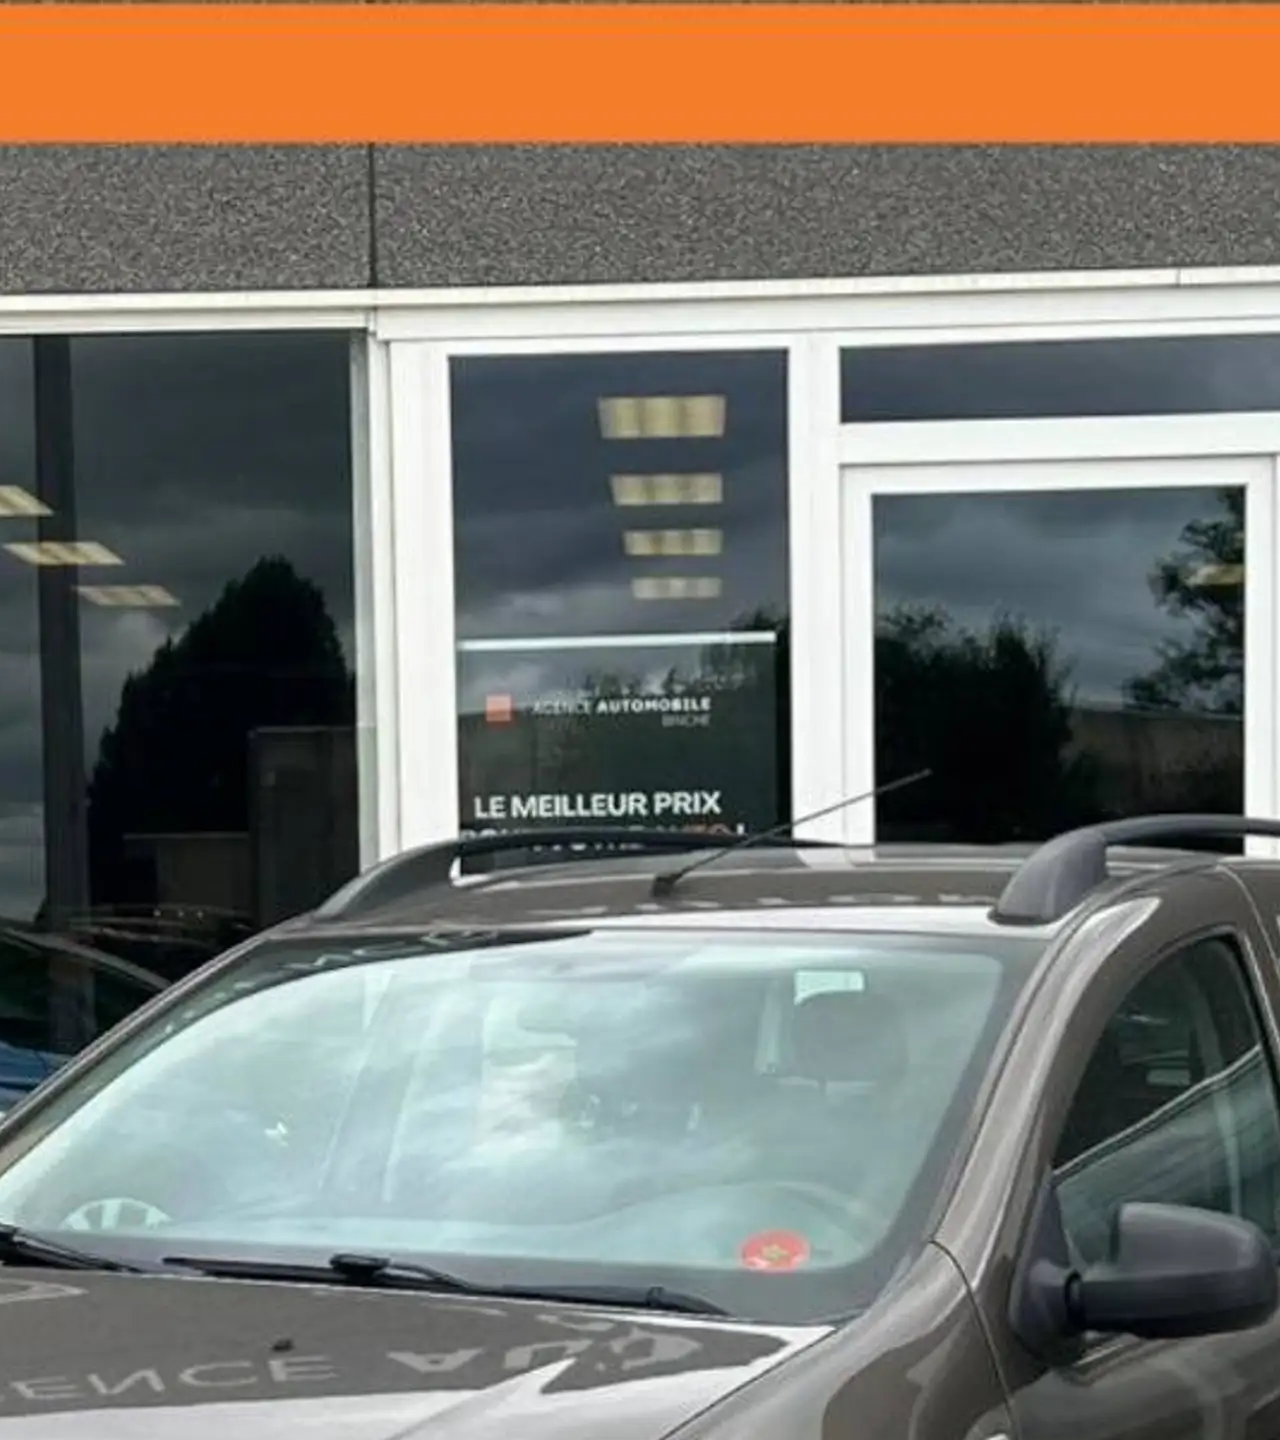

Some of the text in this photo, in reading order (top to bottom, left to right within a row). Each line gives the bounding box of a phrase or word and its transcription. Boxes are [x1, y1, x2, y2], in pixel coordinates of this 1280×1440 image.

[596, 696, 711, 713] AUTOMOBILE
[474, 791, 722, 819] LE MEILLEUR PRIX
